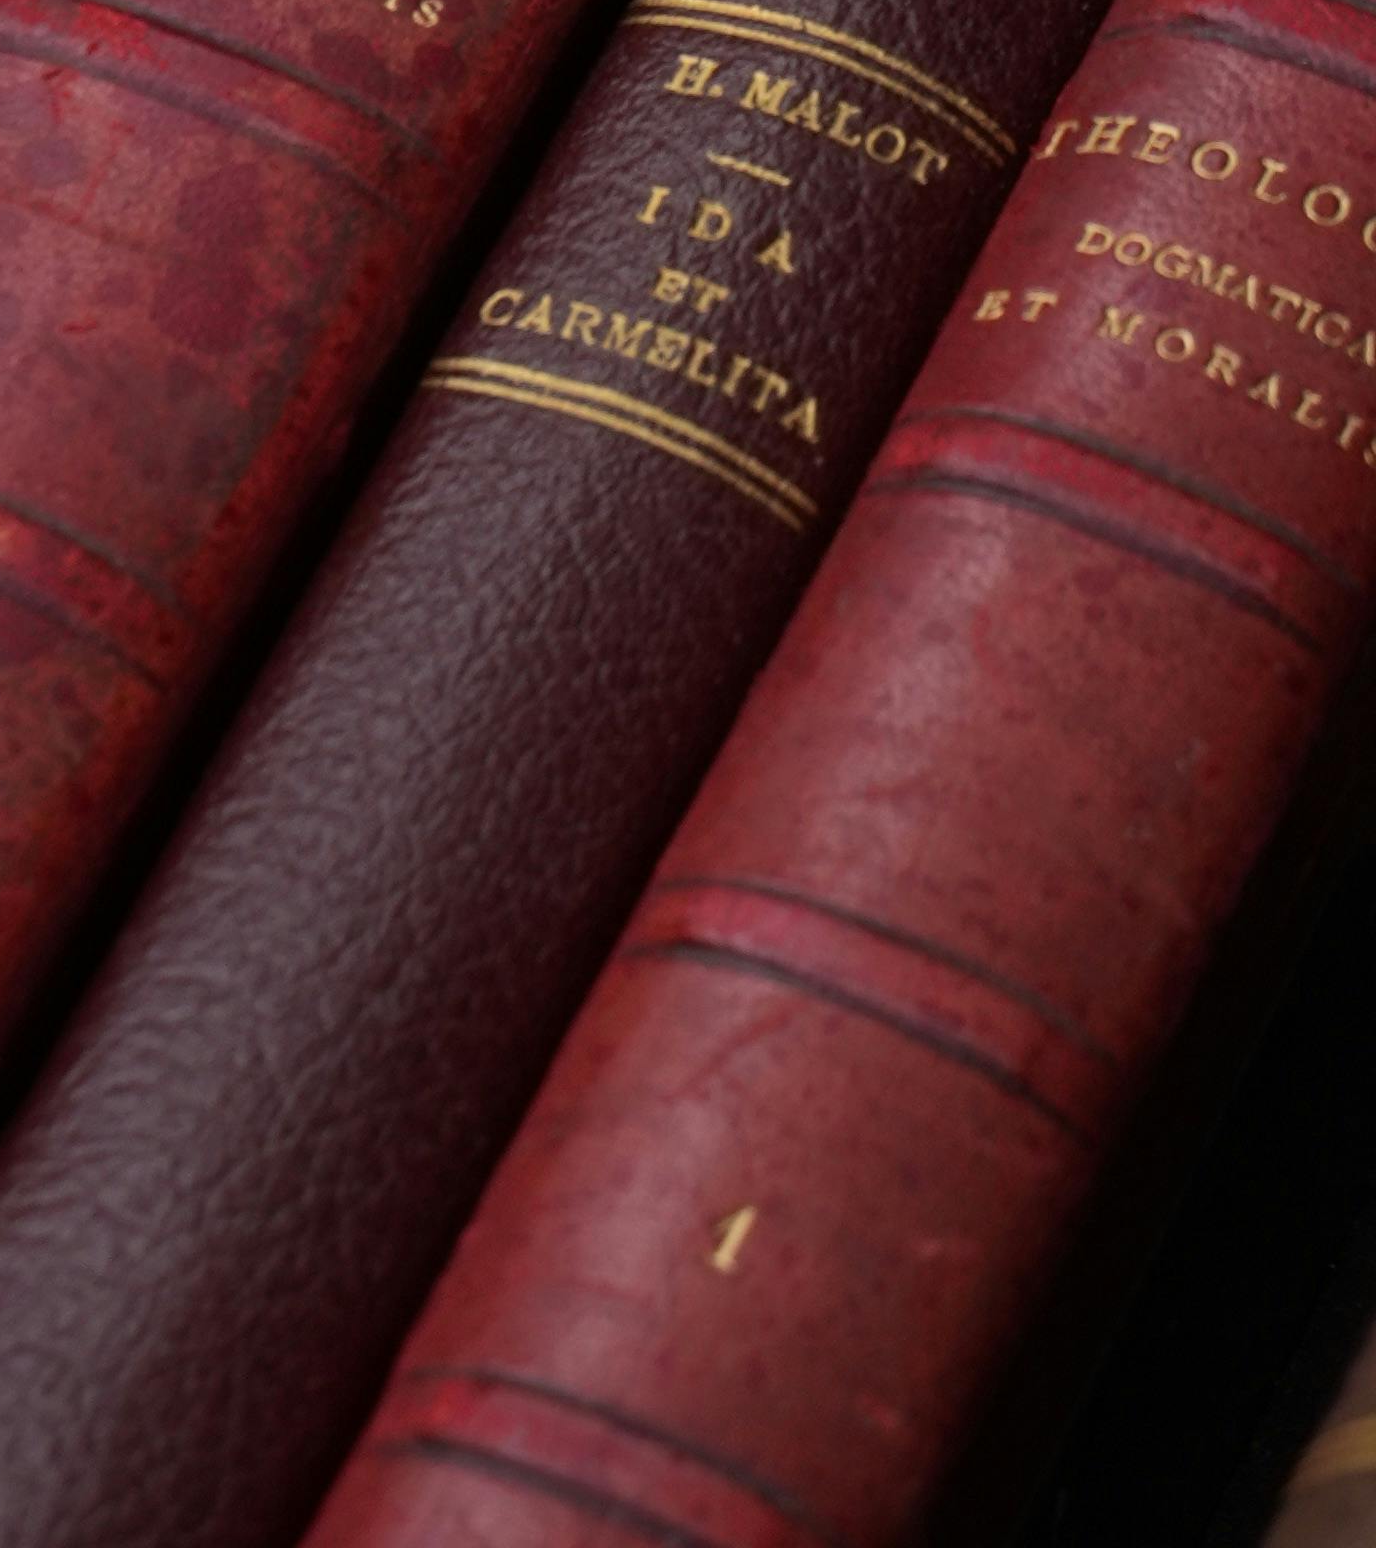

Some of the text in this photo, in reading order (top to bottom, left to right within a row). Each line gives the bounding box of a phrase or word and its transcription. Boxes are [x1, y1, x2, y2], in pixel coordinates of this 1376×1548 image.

[664, 54, 949, 185] H. MALOT
[653, 267, 730, 314] ET
[973, 287, 1059, 323] ET
[479, 287, 821, 445] CARMELITA
[711, 1205, 758, 1275] 1
